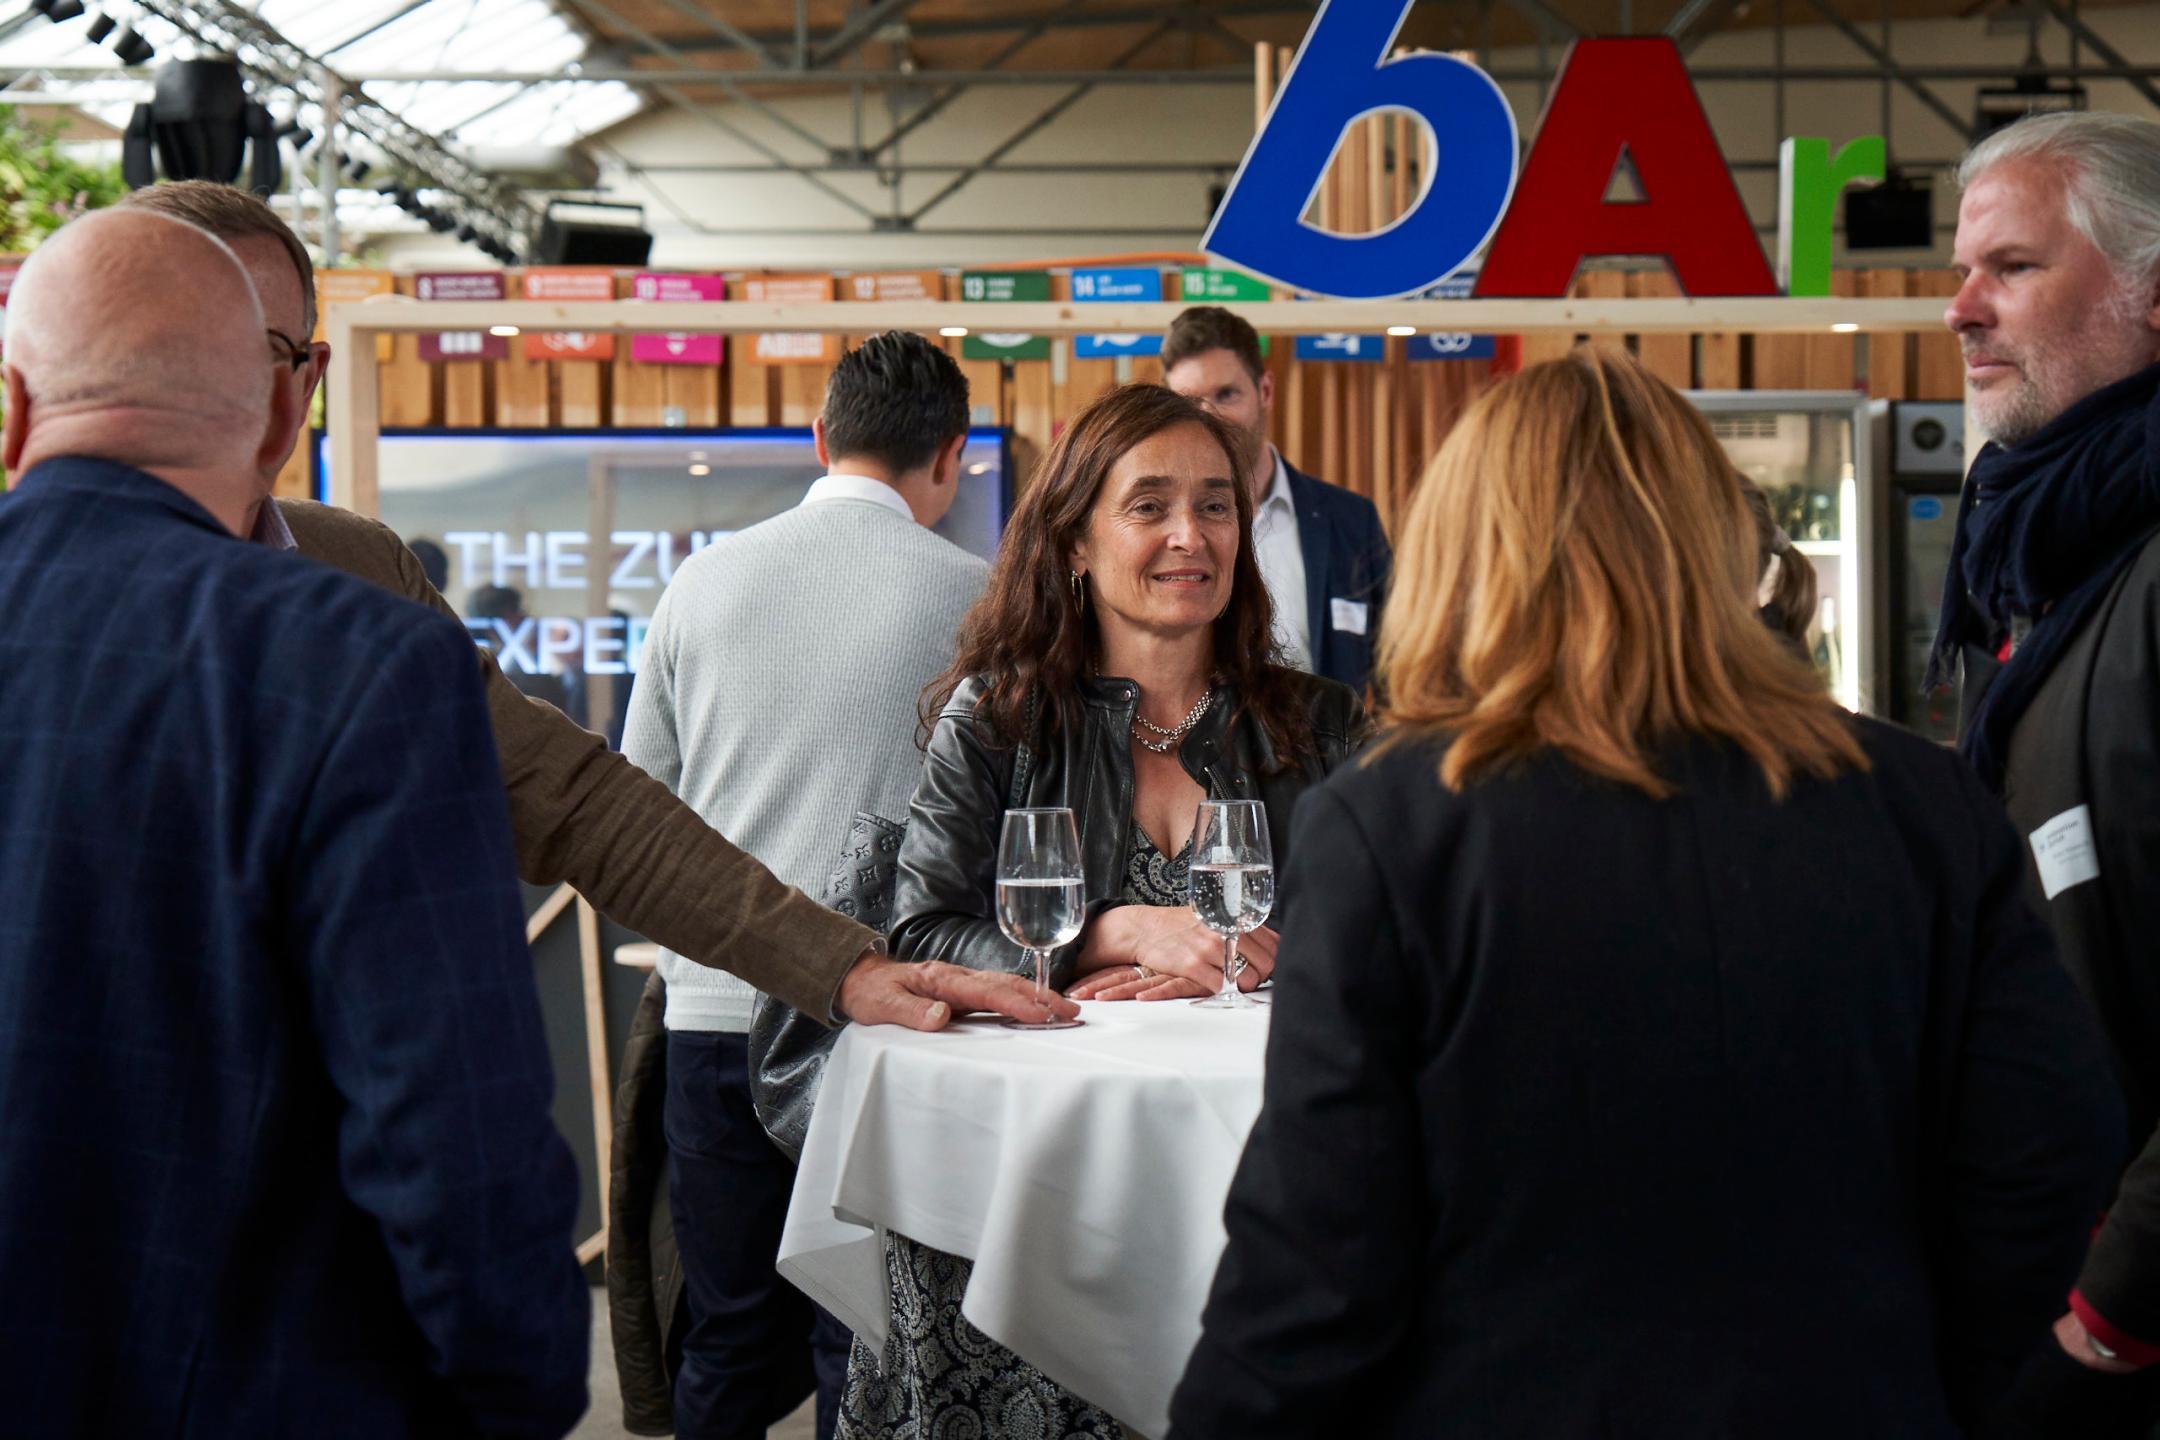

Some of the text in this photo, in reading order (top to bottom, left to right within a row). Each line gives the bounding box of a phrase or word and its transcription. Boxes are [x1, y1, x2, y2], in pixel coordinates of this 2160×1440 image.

[1199, 0, 1886, 299] bAr
[964, 276, 985, 299] 13
[1074, 275, 1095, 297] 14
[444, 530, 741, 589] THE ZU
